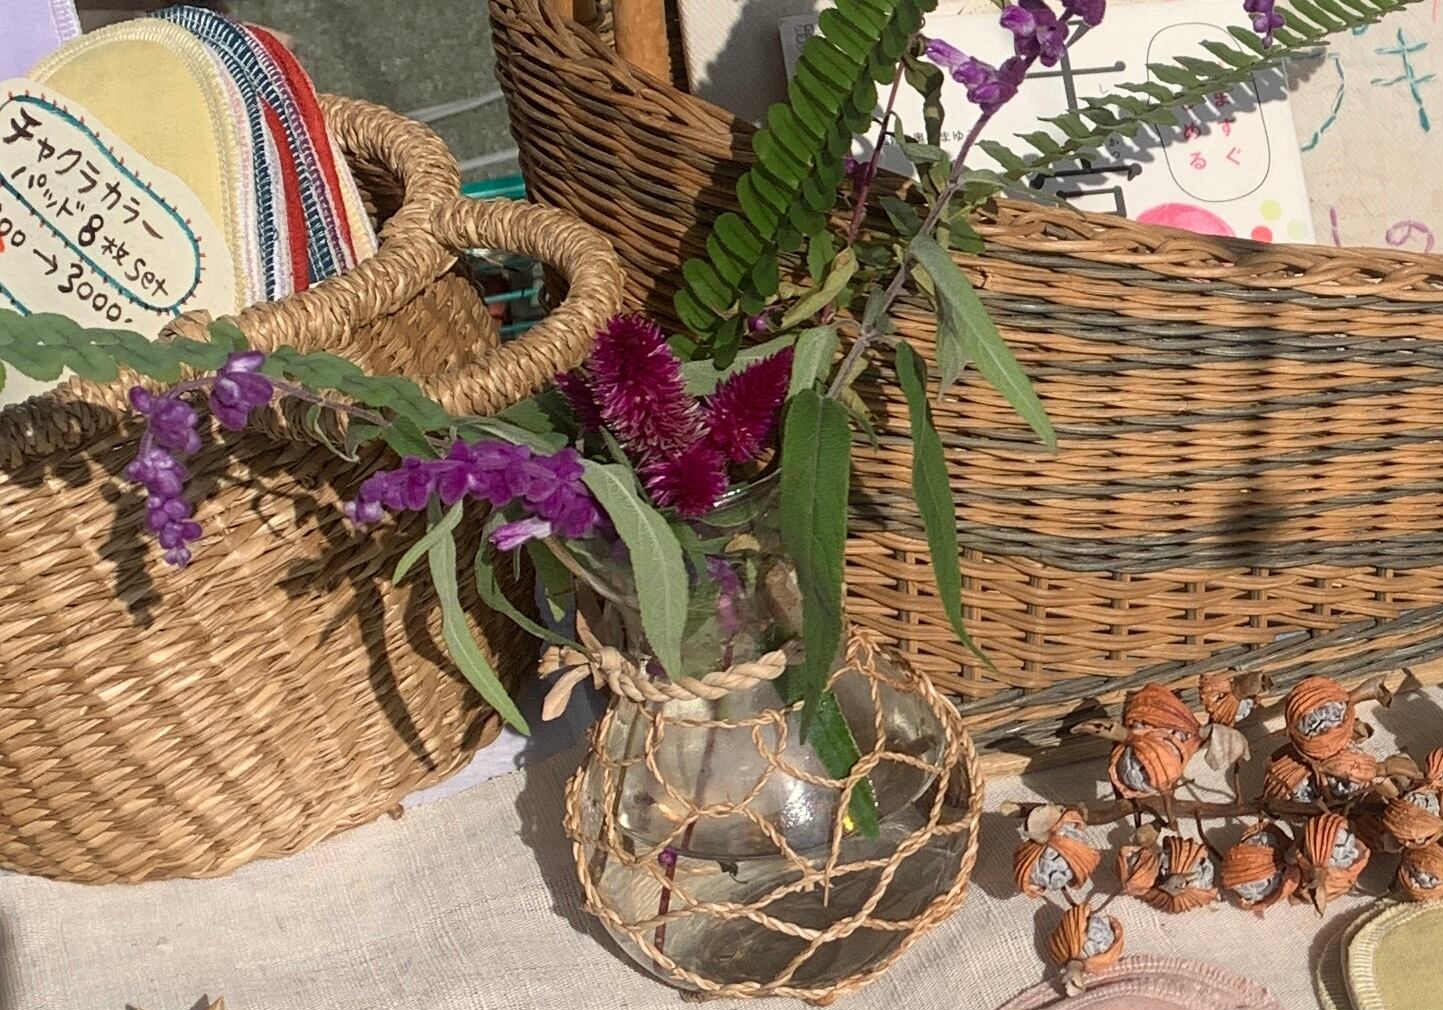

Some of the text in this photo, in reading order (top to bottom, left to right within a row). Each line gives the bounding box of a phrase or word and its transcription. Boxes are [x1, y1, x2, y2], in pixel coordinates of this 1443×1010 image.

[3, 107, 163, 240] チャクラカラー
[1213, 90, 1242, 167] ますぐ
